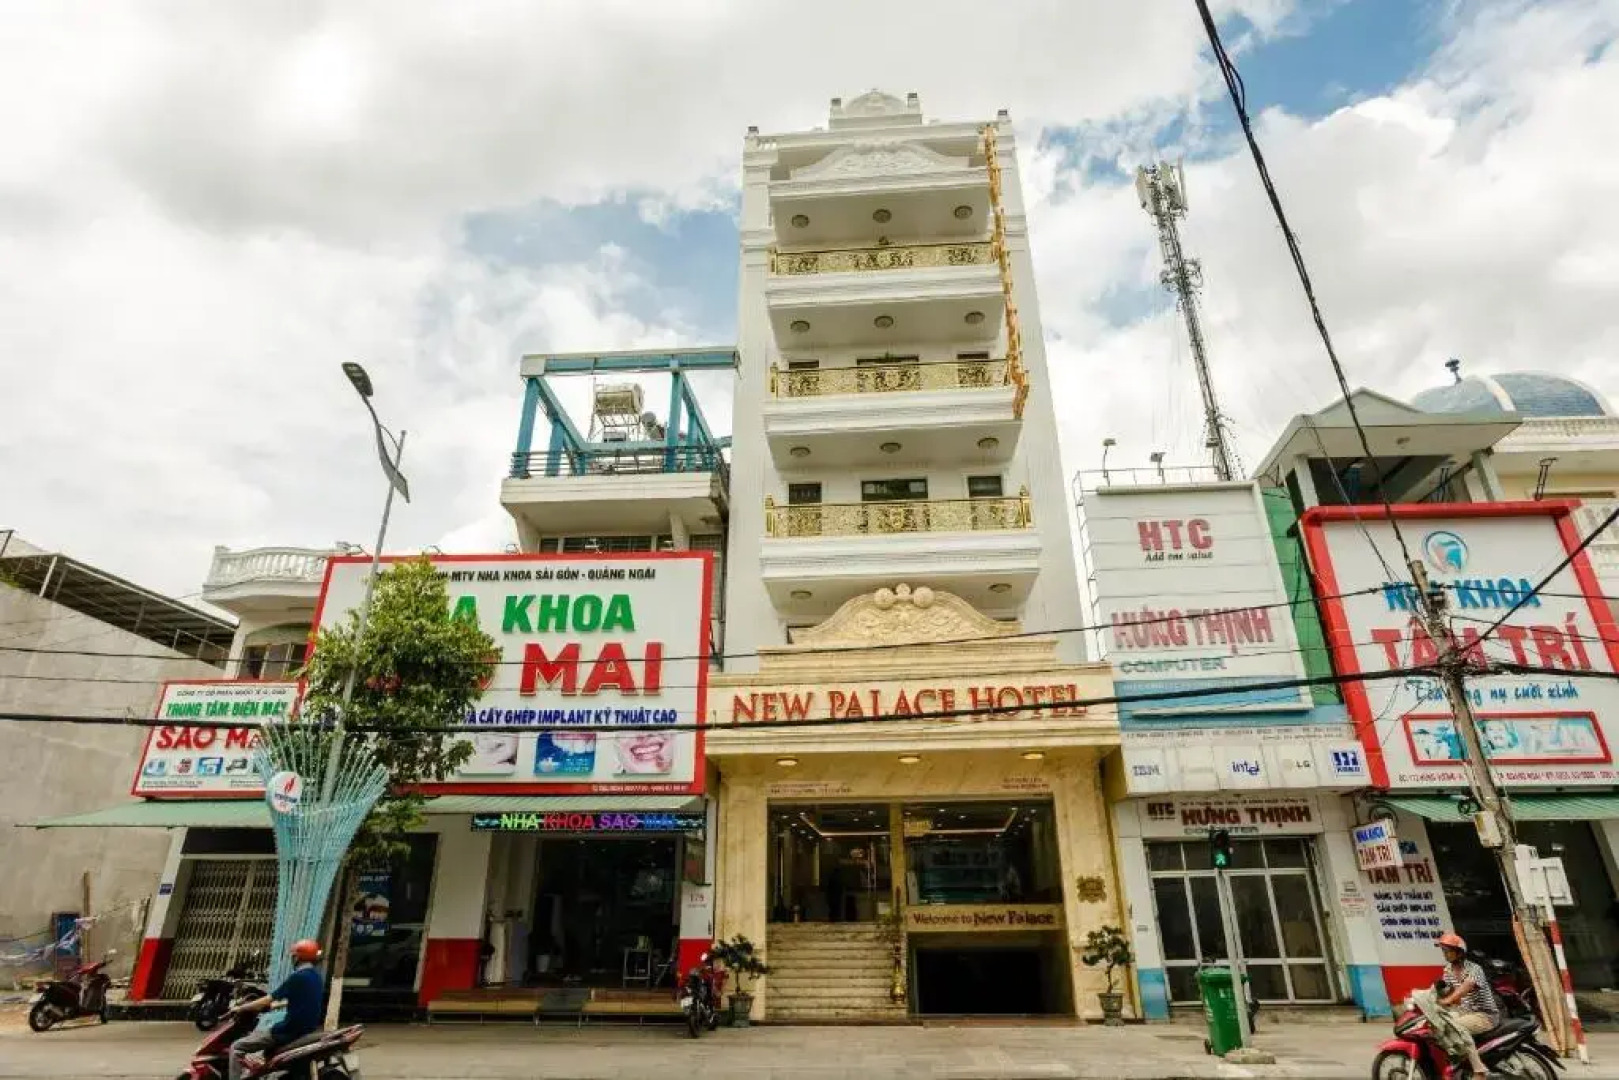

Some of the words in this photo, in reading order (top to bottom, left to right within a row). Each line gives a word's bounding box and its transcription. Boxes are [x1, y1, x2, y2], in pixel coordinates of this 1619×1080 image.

[1138, 519, 1213, 551] HTC
[1145, 551, 1165, 562] Add
[477, 571, 500, 582] NHA
[503, 570, 532, 581] KHOA
[1454, 578, 1541, 608] KHOA
[502, 594, 635, 633] KHOA
[1111, 605, 1188, 648] HƯNG
[1187, 608, 1274, 654] THỊNH
[1497, 611, 1592, 671] TRÍ
[519, 642, 662, 696] MAI
[1120, 657, 1227, 673] COMPUTER
[1548, 679, 1578, 699] xinh
[166, 703, 202, 716] TRUNG
[206, 700, 230, 716] TÂM
[538, 709, 592, 724] IMPLANT
[652, 709, 677, 723] CAO
[732, 691, 814, 727] NEW
[828, 688, 955, 722] PALACE
[968, 684, 1088, 718] HOTEL
[156, 726, 217, 749] SAO
[1148, 802, 1175, 816] HTC
[1181, 805, 1241, 826] HƯNG
[1245, 805, 1312, 828] THỊNH
[501, 813, 538, 829] NHA
[543, 813, 595, 829] KHOA
[599, 813, 639, 829] SAO
[1403, 857, 1434, 883] TRÍ
[914, 912, 958, 925] Welcome
[961, 912, 972, 924] to
[974, 911, 1005, 927] New
[1008, 910, 1054, 925] Palace
